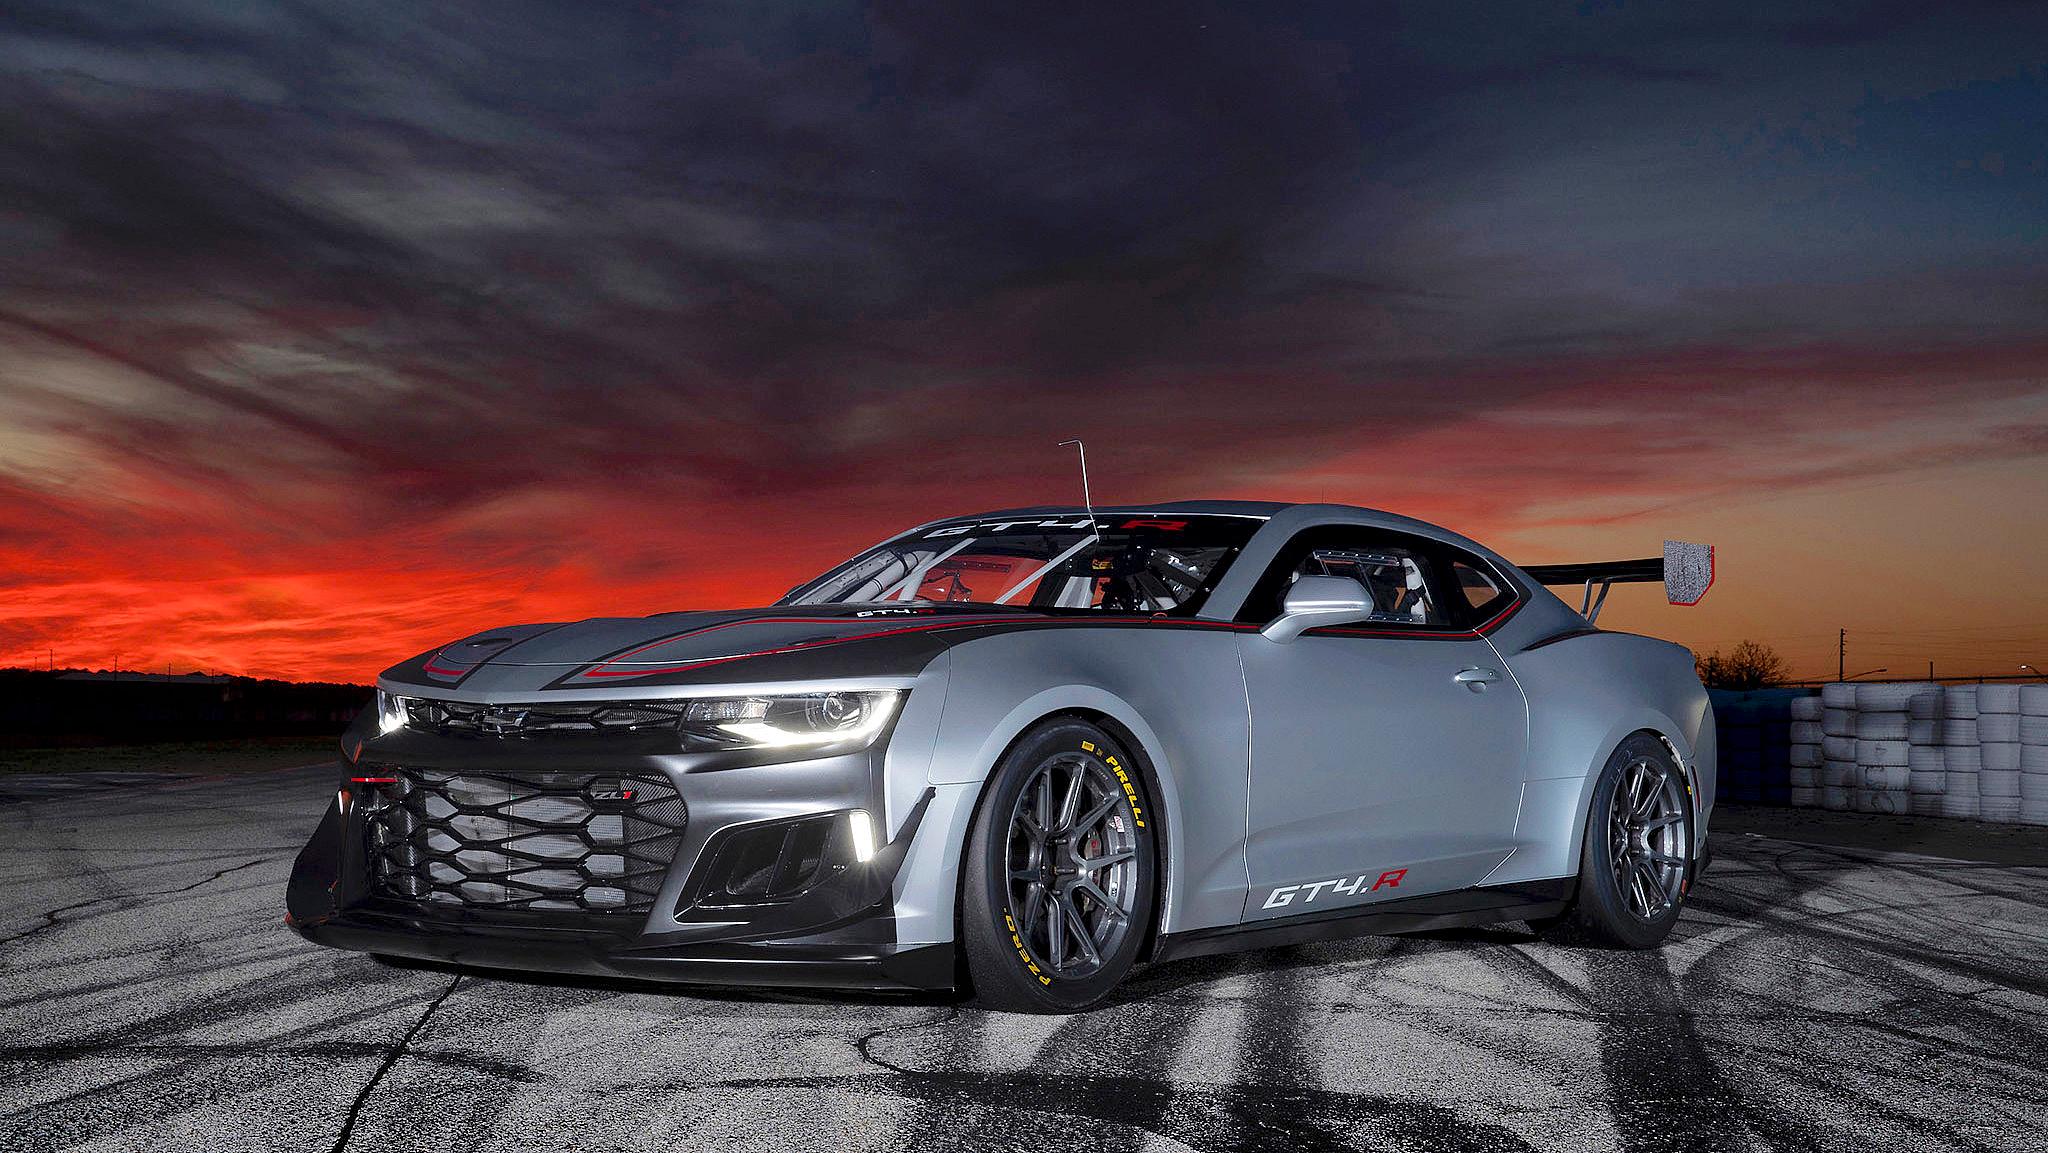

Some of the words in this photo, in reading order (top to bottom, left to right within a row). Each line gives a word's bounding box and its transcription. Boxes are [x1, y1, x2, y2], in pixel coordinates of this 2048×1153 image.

[593, 791, 632, 800] ZL1
[1105, 755, 1145, 828] PIRELLI
[1261, 868, 1409, 910] GT4.R
